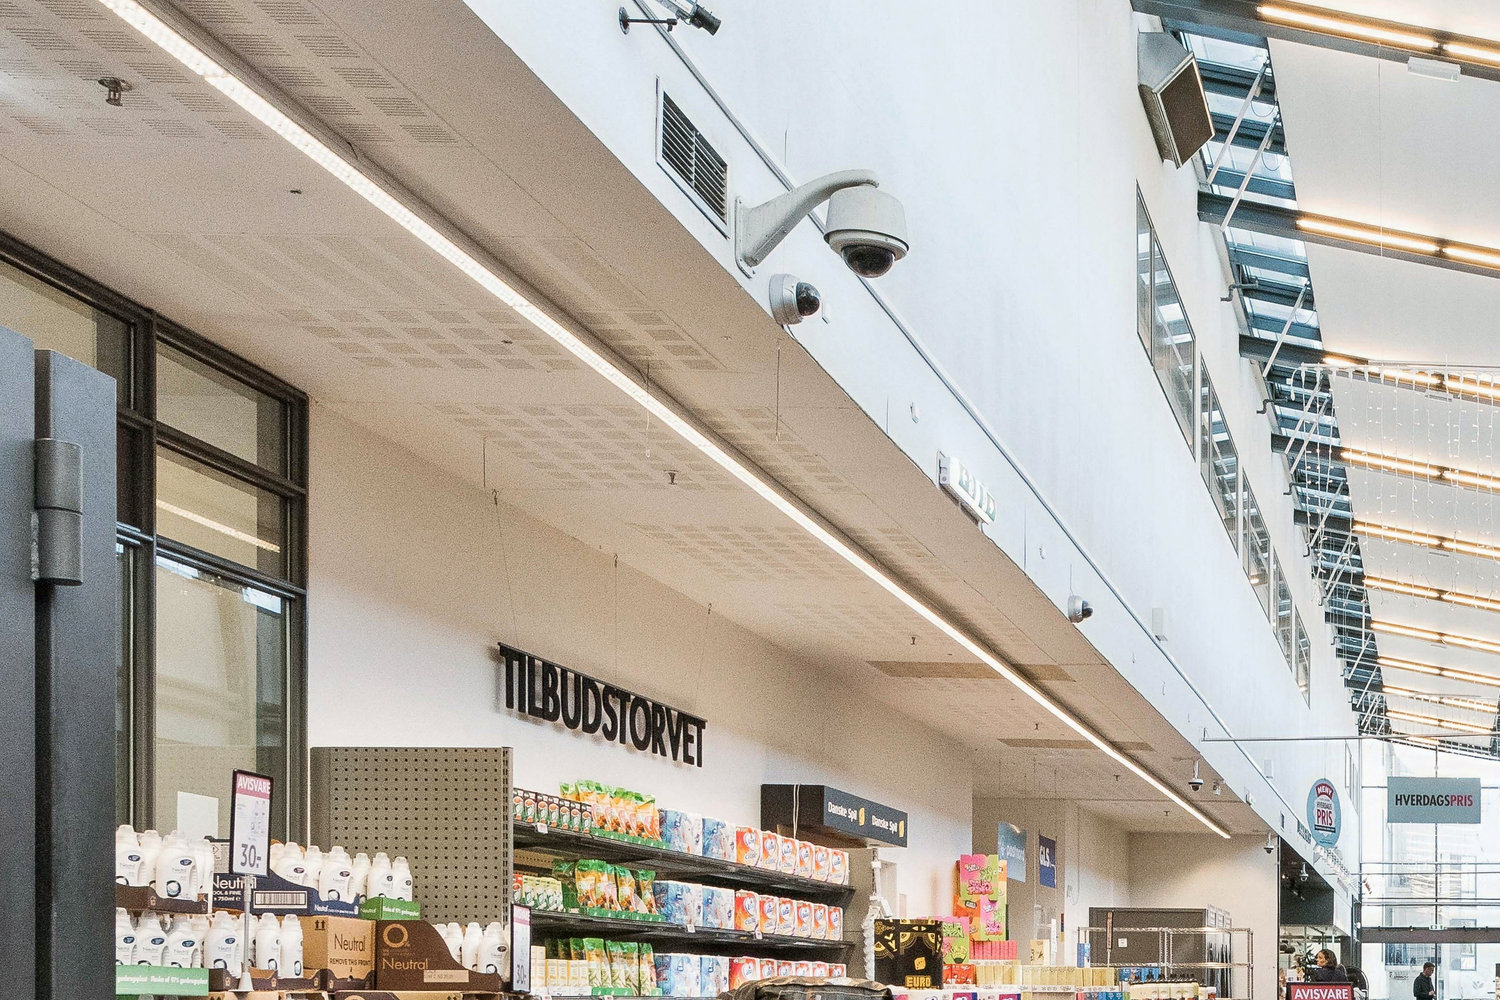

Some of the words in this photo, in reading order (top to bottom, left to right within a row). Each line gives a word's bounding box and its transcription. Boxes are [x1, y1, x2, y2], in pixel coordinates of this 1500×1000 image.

[499, 645, 706, 767] TILBUDSTORVET
[238, 776, 271, 794] AVISVARE
[1395, 794, 1473, 807] HVERDAGSPRIS
[828, 802, 848, 818] Danske
[1317, 809, 1333, 826] PRIS
[872, 815, 890, 830] Danske
[1040, 845, 1050, 868] GLS
[334, 933, 366, 952] Neutral
[382, 958, 429, 970] Neutral
[906, 976, 932, 988] EURO
[1294, 988, 1348, 1000] AVISVARE
